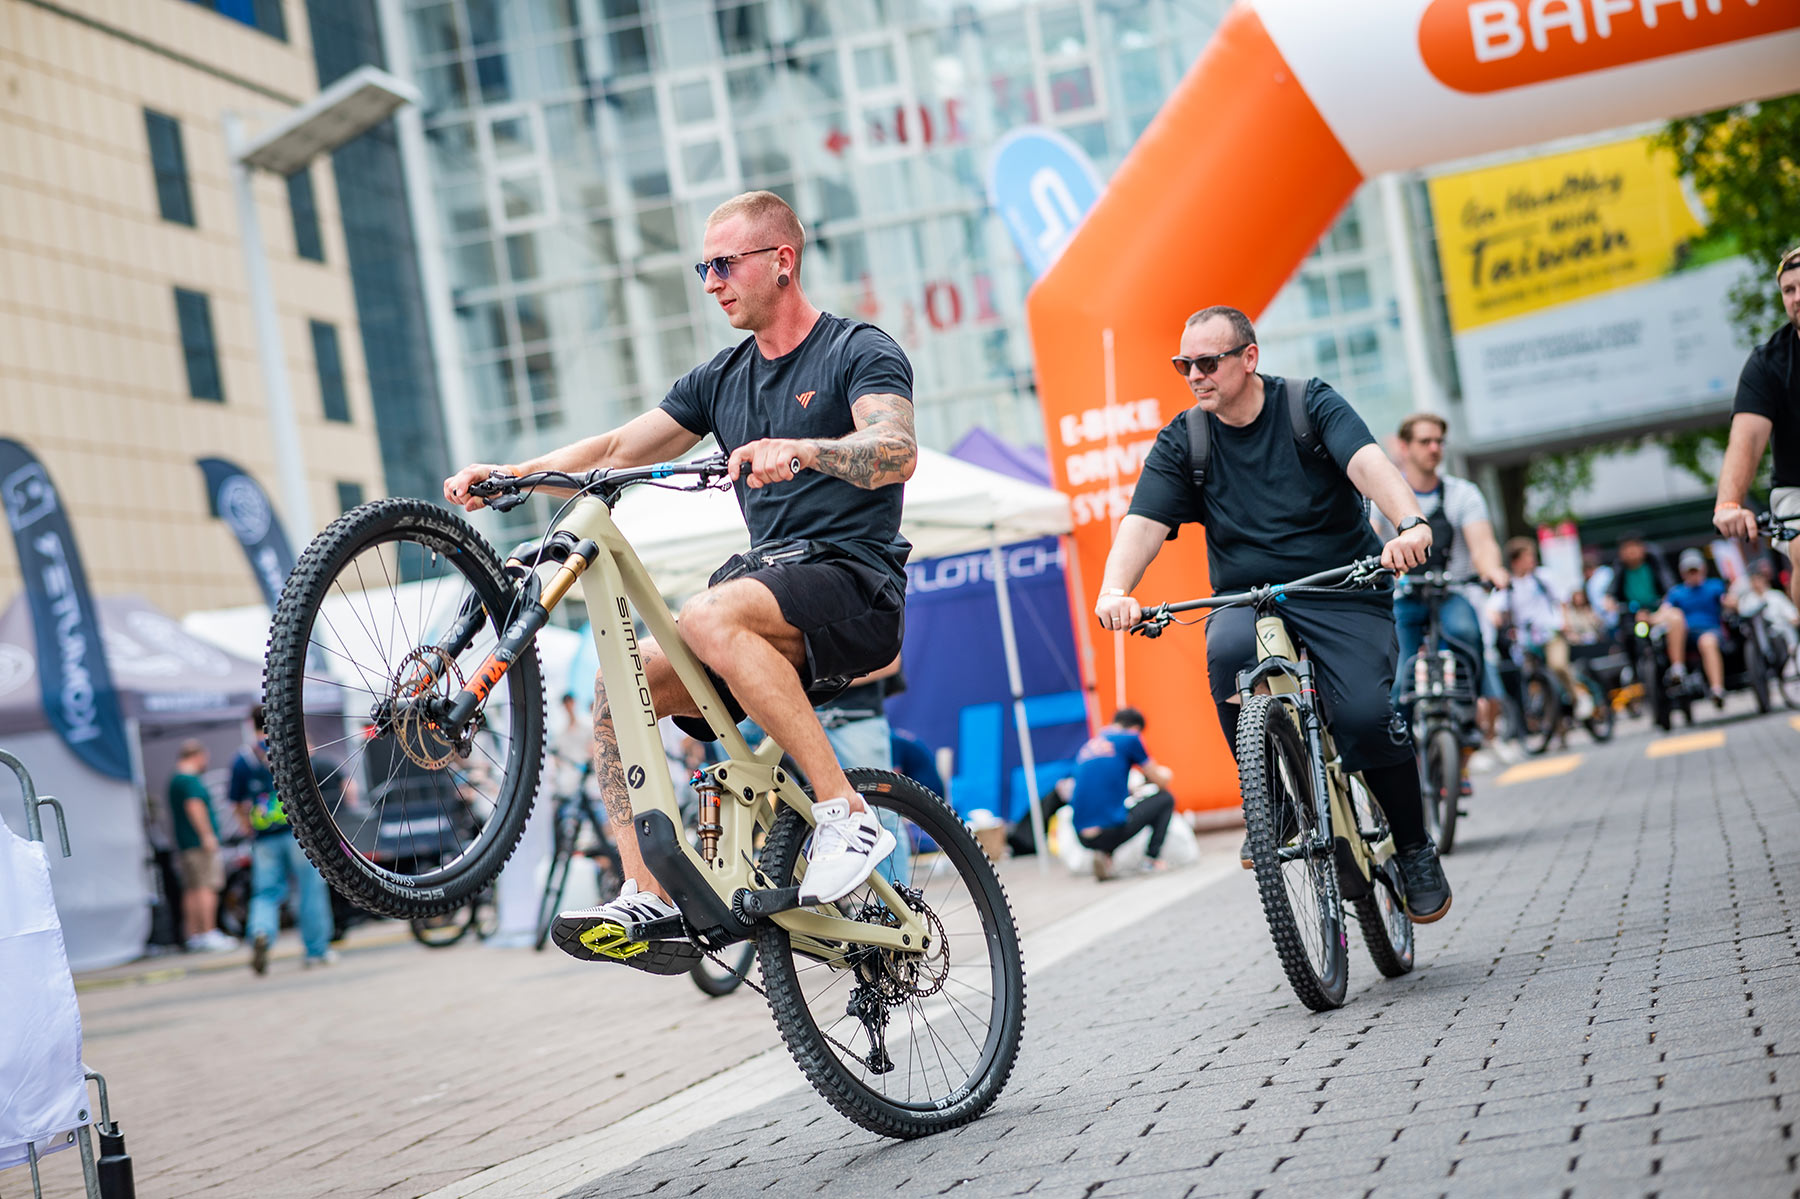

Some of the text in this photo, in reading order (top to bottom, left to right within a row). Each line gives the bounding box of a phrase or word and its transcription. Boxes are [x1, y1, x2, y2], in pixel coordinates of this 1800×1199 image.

[1465, 221, 1630, 290] Taiwan
[1059, 397, 1162, 448] E-BIKE
[616, 596, 656, 727] SIMPLON
[389, 871, 416, 888] SWISS
[934, 1086, 971, 1111] DT SWISS
